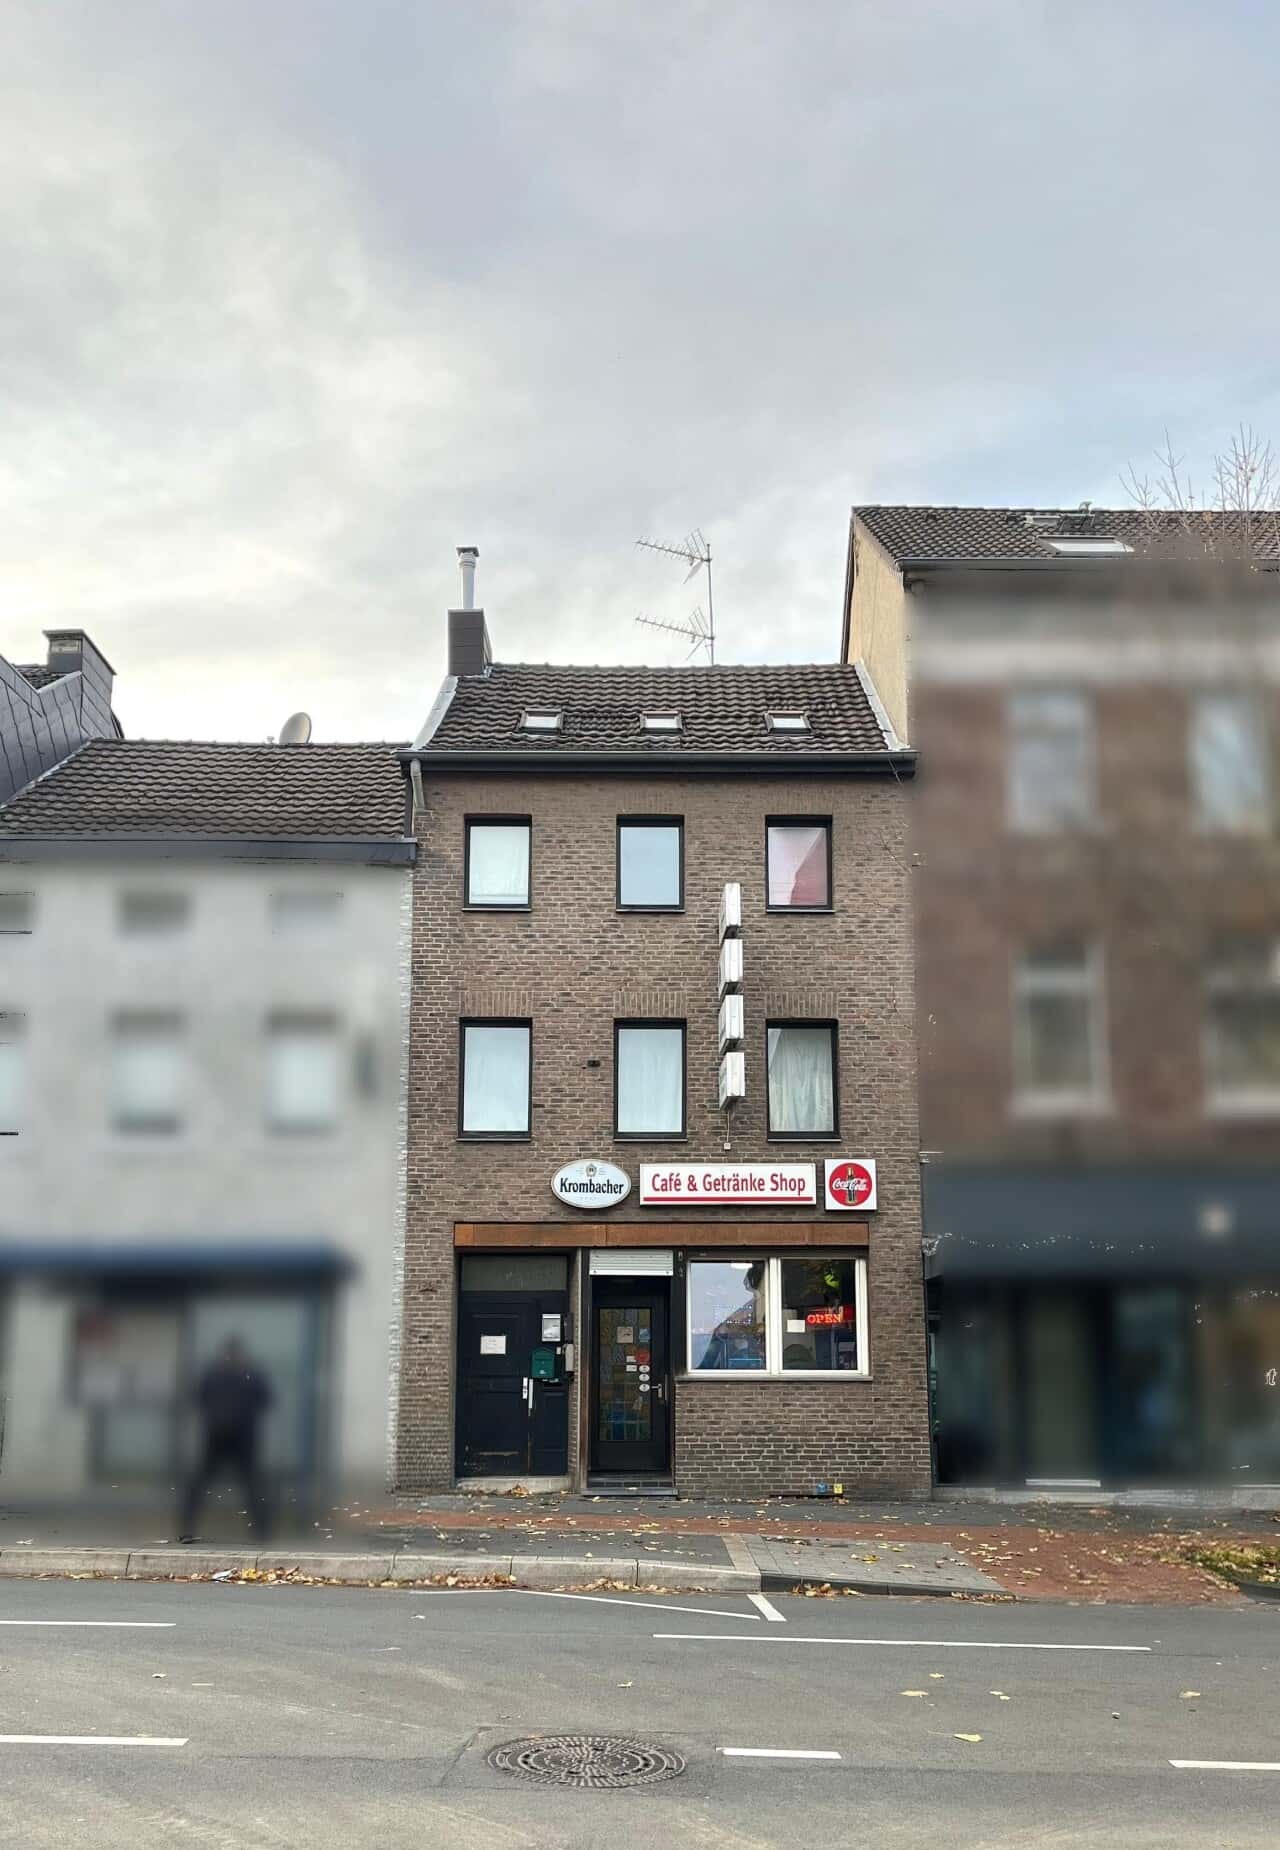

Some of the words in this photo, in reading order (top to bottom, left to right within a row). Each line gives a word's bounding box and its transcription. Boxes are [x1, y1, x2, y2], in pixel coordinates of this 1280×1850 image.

[559, 1177, 624, 1194] Krombacher
[652, 1172, 682, 1192] Café
[687, 1174, 698, 1192] &
[703, 1172, 765, 1192] Getränke
[770, 1172, 806, 1196] Shop
[807, 1313, 841, 1324] OPEN
